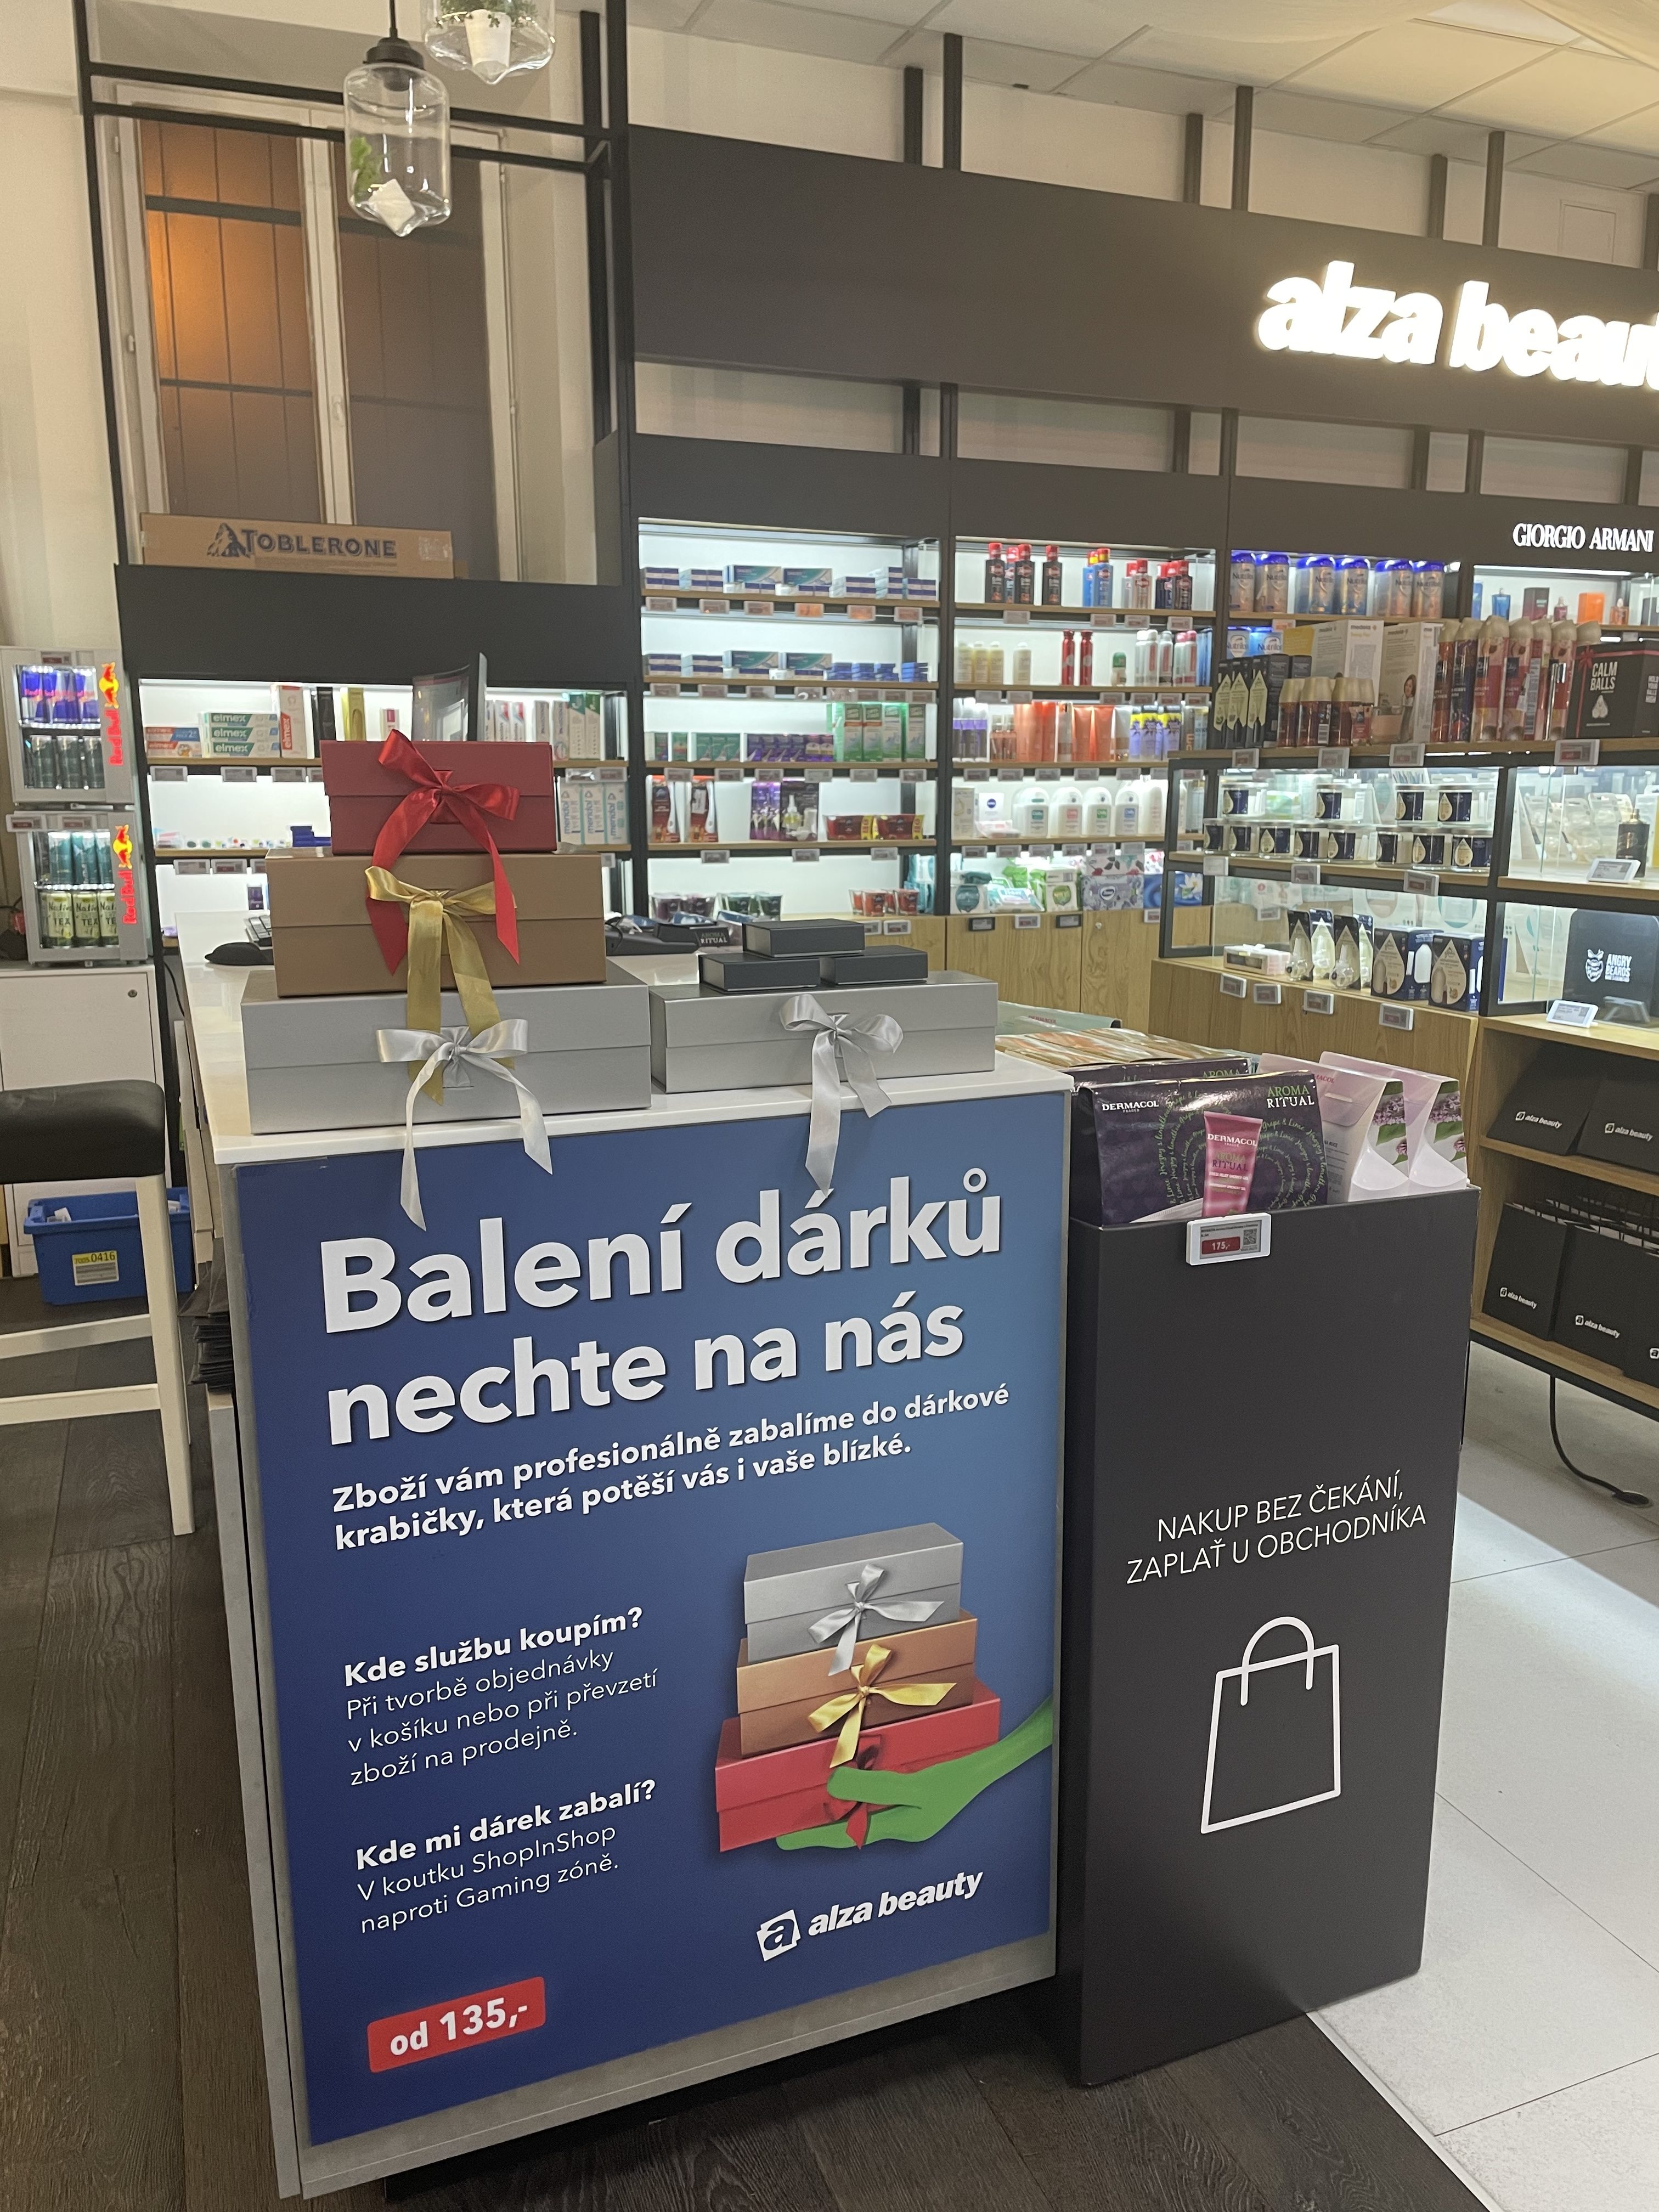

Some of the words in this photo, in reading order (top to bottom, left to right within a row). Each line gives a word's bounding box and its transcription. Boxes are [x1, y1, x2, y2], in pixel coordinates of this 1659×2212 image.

[1258, 260, 1443, 364] alza
[1449, 280, 1659, 391] beau
[241, 529, 397, 558] TOBLERONE
[1513, 523, 1585, 549] GIORGIO
[1589, 527, 1655, 552] ARMANI
[1590, 676, 1615, 691] BALLS
[1592, 662, 1617, 678] CALM
[213, 714, 246, 723] elmex
[283, 718, 291, 748] elmex
[213, 729, 246, 738] elmex
[215, 743, 248, 752] elmex
[1606, 954, 1632, 968] ANGRY
[1606, 965, 1630, 977] BEARDS
[1267, 1084, 1310, 1097] AROMA
[1267, 1095, 1315, 1109] RITUAL
[1102, 1100, 1160, 1111] DERMACOL
[1525, 1115, 1539, 1123] alza
[1538, 1117, 1562, 1129] beauty
[1615, 1126, 1629, 1135] alza
[1629, 1128, 1654, 1142] beauty
[1207, 1133, 1257, 1147] DERMACOL
[1212, 1159, 1248, 1172] RITUAL
[91, 1251, 115, 1262] 0416
[320, 1203, 692, 1333] Balení
[716, 1167, 1000, 1283] dárků
[1507, 1291, 1518, 1301] alza
[1518, 1295, 1537, 1309] beauty
[1584, 1319, 1598, 1329] alza
[1598, 1324, 1620, 1339] beauty
[328, 1336, 666, 1445] nechte
[695, 1328, 797, 1390] na
[825, 1290, 963, 1371] nás
[332, 1473, 427, 1512] Zboží
[435, 1466, 503, 1494] vám
[514, 1427, 720, 1489] profesionálně
[729, 1412, 854, 1447] zabalíme
[862, 1401, 896, 1425] do
[905, 1383, 1009, 1419] dárkové
[336, 1507, 484, 1550] krabičky,
[493, 1487, 572, 1522] která
[583, 1469, 675, 1514] potěší
[681, 1463, 729, 1489] vás
[737, 1457, 744, 1480] i
[752, 1449, 815, 1477] vaše
[824, 1432, 911, 1466] blízké.
[1158, 1504, 1248, 1542] NAKUP
[1256, 1493, 1302, 1524] BEZ
[1309, 1469, 1403, 1513] ČEKÁNÍ,
[1126, 1538, 1226, 1584] ZAPLAŤ
[1233, 1539, 1249, 1564] U
[1257, 1504, 1426, 1558] OBCHODNÍKA
[345, 1656, 406, 1686] Kde
[415, 1637, 511, 1672] službu
[520, 1606, 642, 1651] koupím?
[347, 1696, 377, 1720] Při
[385, 1677, 467, 1711] tvorbě
[476, 1649, 613, 1692] objednávky
[348, 1737, 362, 1752] v
[370, 1717, 448, 1748] košíku
[457, 1702, 519, 1729] nebo
[528, 1690, 557, 1719] při
[567, 1668, 658, 1711] převzetí
[351, 1752, 417, 1786] zboží
[425, 1751, 453, 1769] na
[462, 1719, 577, 1766] prodejně.
[357, 1839, 416, 1870] Kde
[426, 1825, 460, 1853] mi
[470, 1805, 552, 1842] dárek
[559, 1779, 656, 1821] zabalí?
[357, 1880, 375, 1900] V
[383, 1863, 464, 1896] koutku
[472, 1827, 616, 1873] ShopInShop
[362, 1894, 448, 1933] naproti
[456, 1874, 550, 1908] Gaming
[557, 1853, 618, 1883] zóně.
[808, 1902, 873, 1936] alza
[878, 1871, 983, 1917] beauty
[390, 2021, 428, 2055] od
[439, 1997, 527, 2040] 135,-
